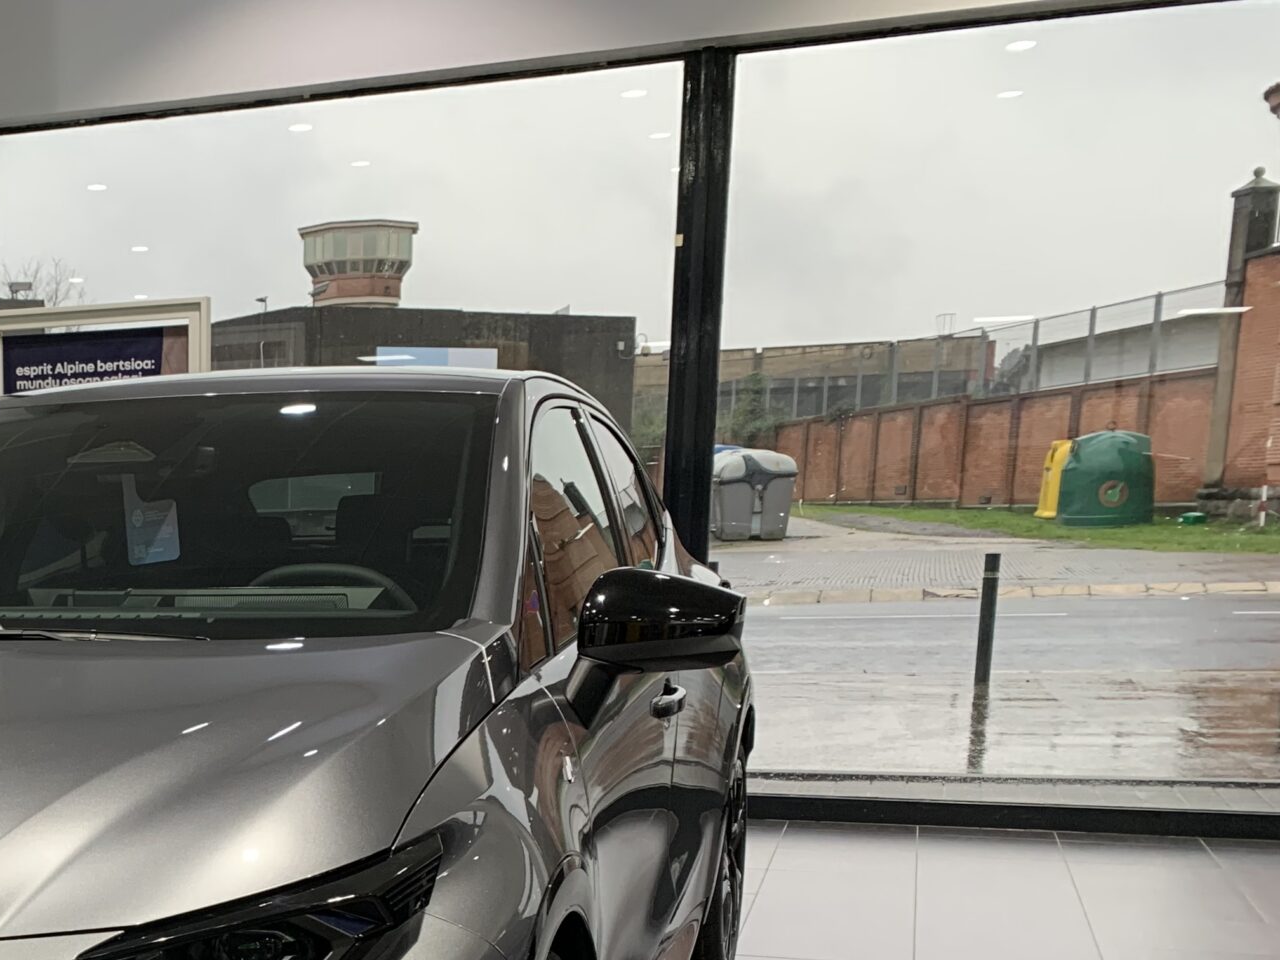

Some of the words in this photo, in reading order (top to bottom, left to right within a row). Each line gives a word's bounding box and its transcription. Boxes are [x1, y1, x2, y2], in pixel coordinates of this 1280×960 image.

[16, 363, 53, 378] esprit
[54, 361, 95, 376] Alpine
[97, 358, 156, 372] bertsioa:
[16, 377, 60, 390] mundu
